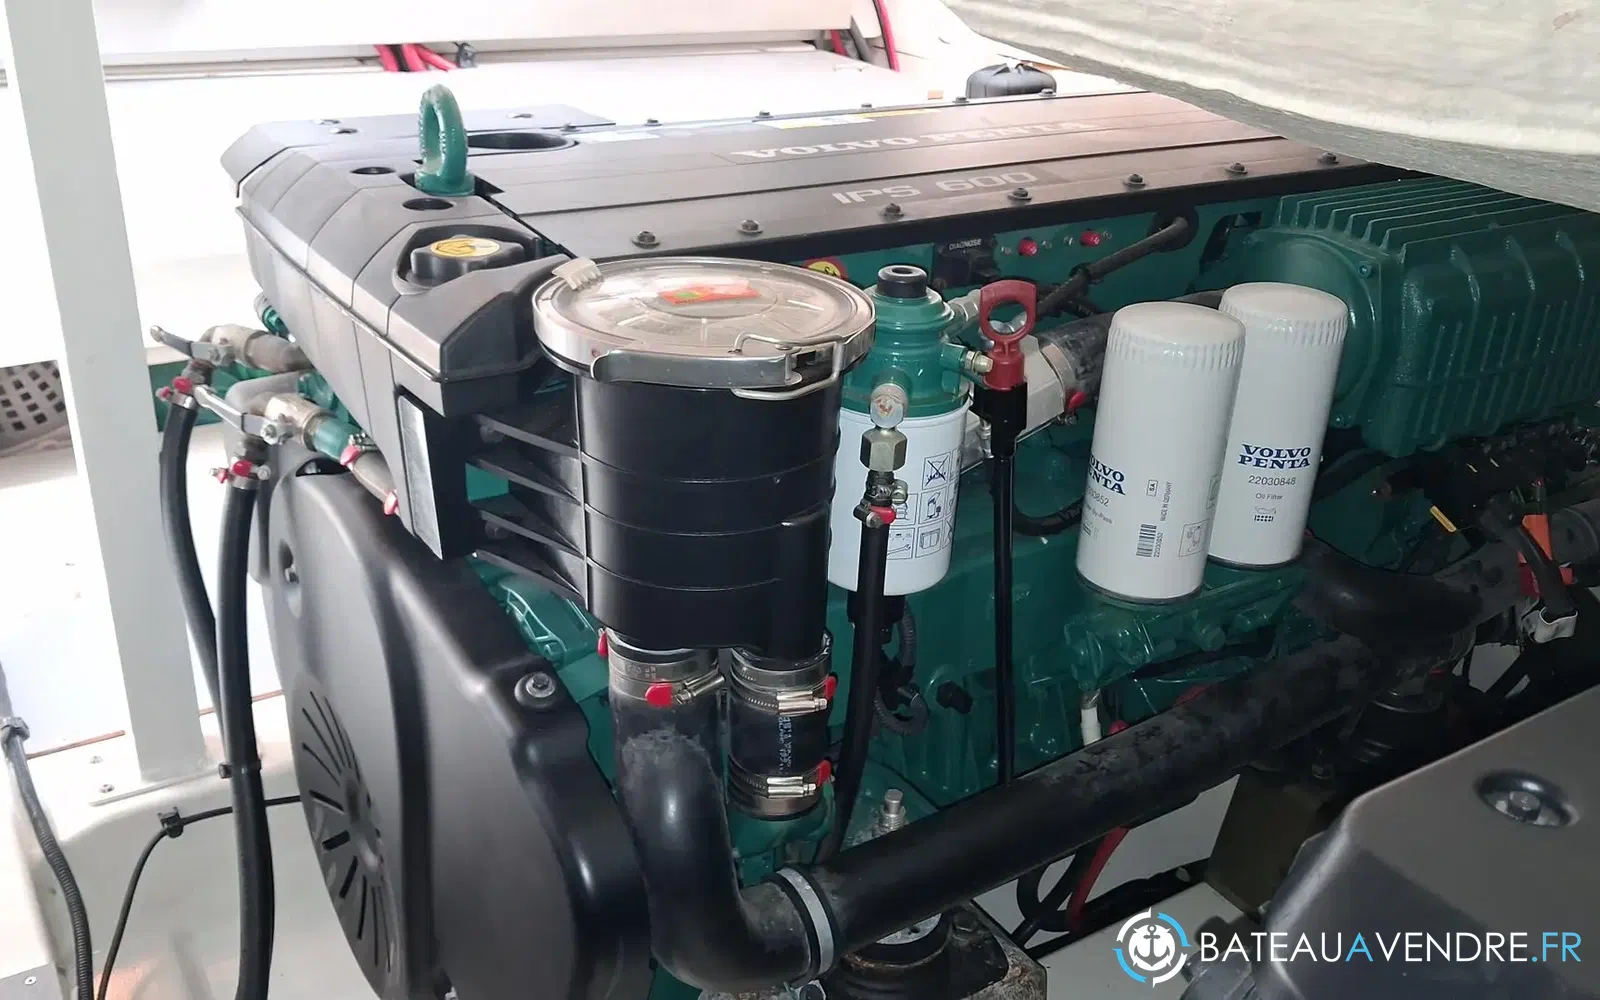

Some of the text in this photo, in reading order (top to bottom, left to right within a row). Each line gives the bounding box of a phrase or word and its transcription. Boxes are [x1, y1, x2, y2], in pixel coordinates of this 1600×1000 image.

[729, 122, 1098, 158] VOLVO PENTA
[832, 172, 1039, 205] IPS 600
[948, 238, 982, 251] DIAGNOSE
[1242, 444, 1312, 459] VOLVO
[1089, 453, 1125, 483] OLVO
[1238, 455, 1311, 470] PENTA
[1248, 475, 1297, 486] 22030848
[1255, 492, 1266, 500] Oil
